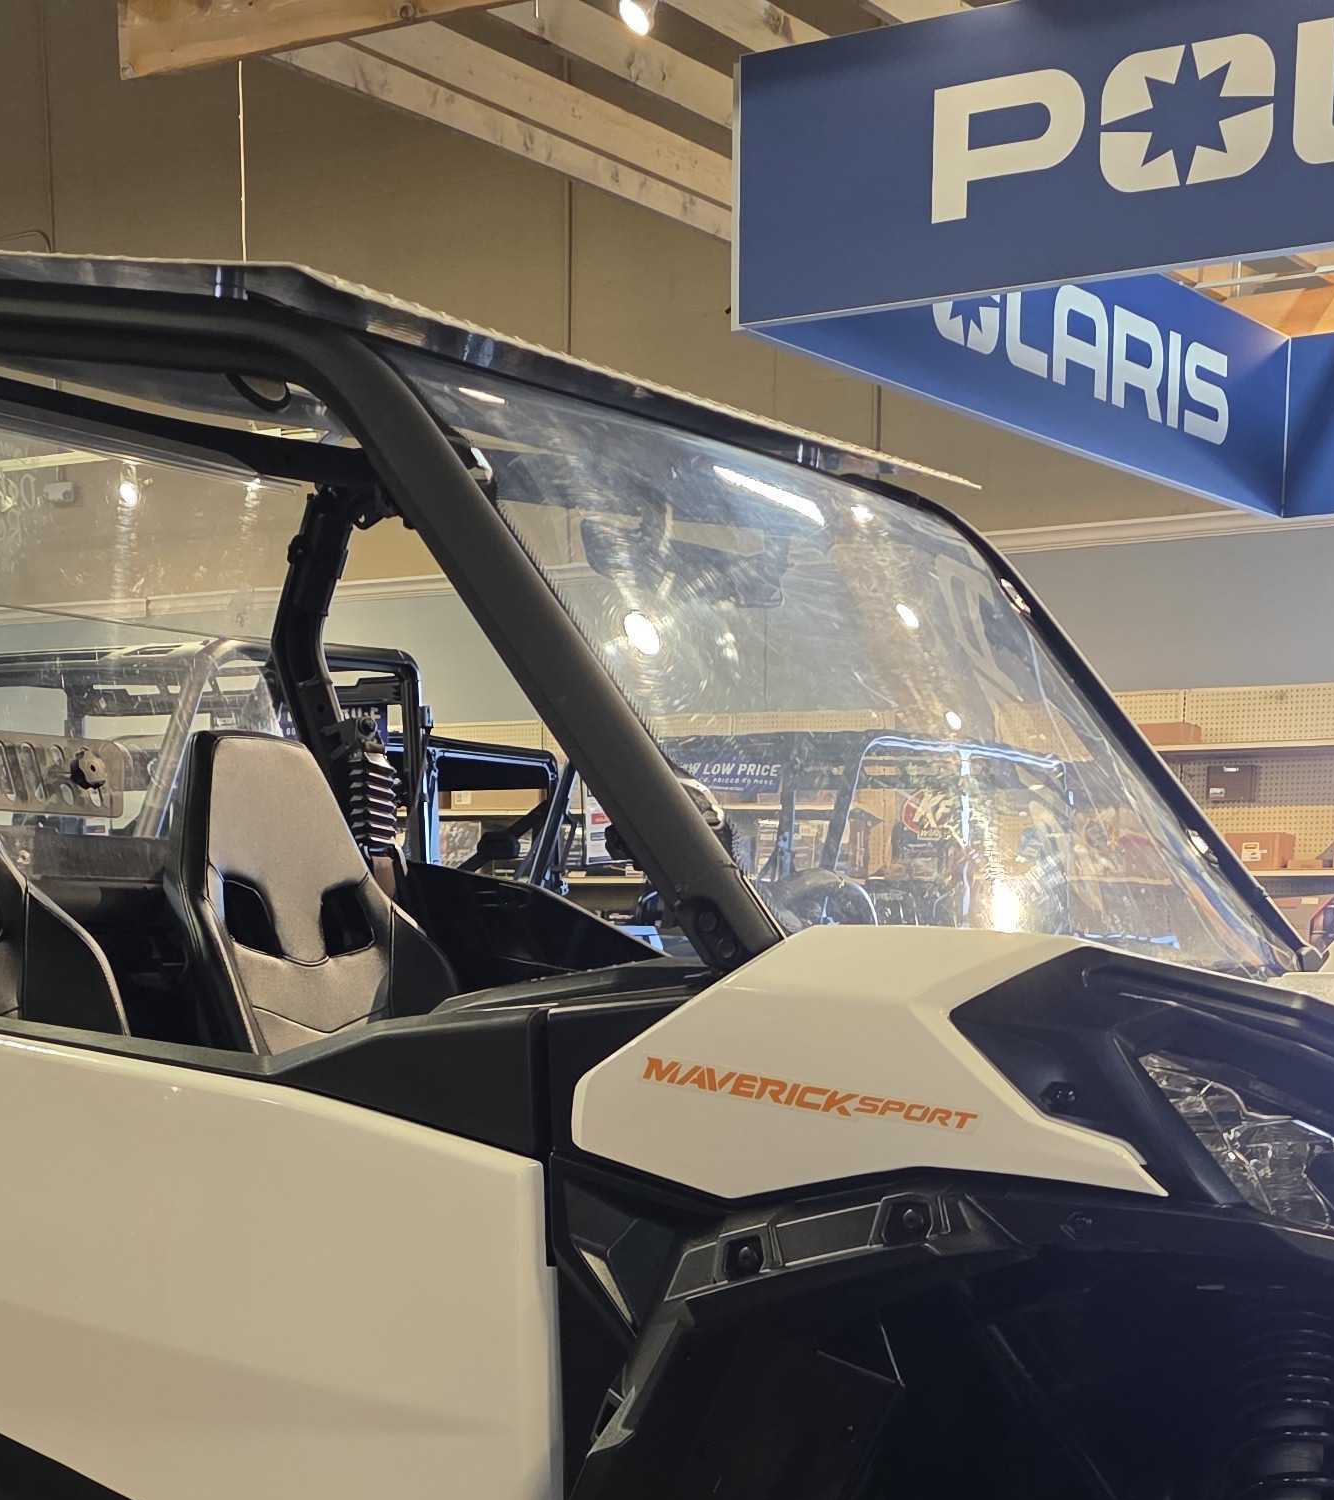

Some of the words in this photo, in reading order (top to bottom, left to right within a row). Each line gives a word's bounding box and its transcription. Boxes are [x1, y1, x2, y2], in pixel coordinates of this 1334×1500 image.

[932, 284, 1229, 445] OLARIS
[703, 763, 736, 775] LOW
[737, 763, 782, 777] PRICE
[642, 1056, 860, 1117] MAVERICK
[854, 1095, 979, 1129] SPORT
